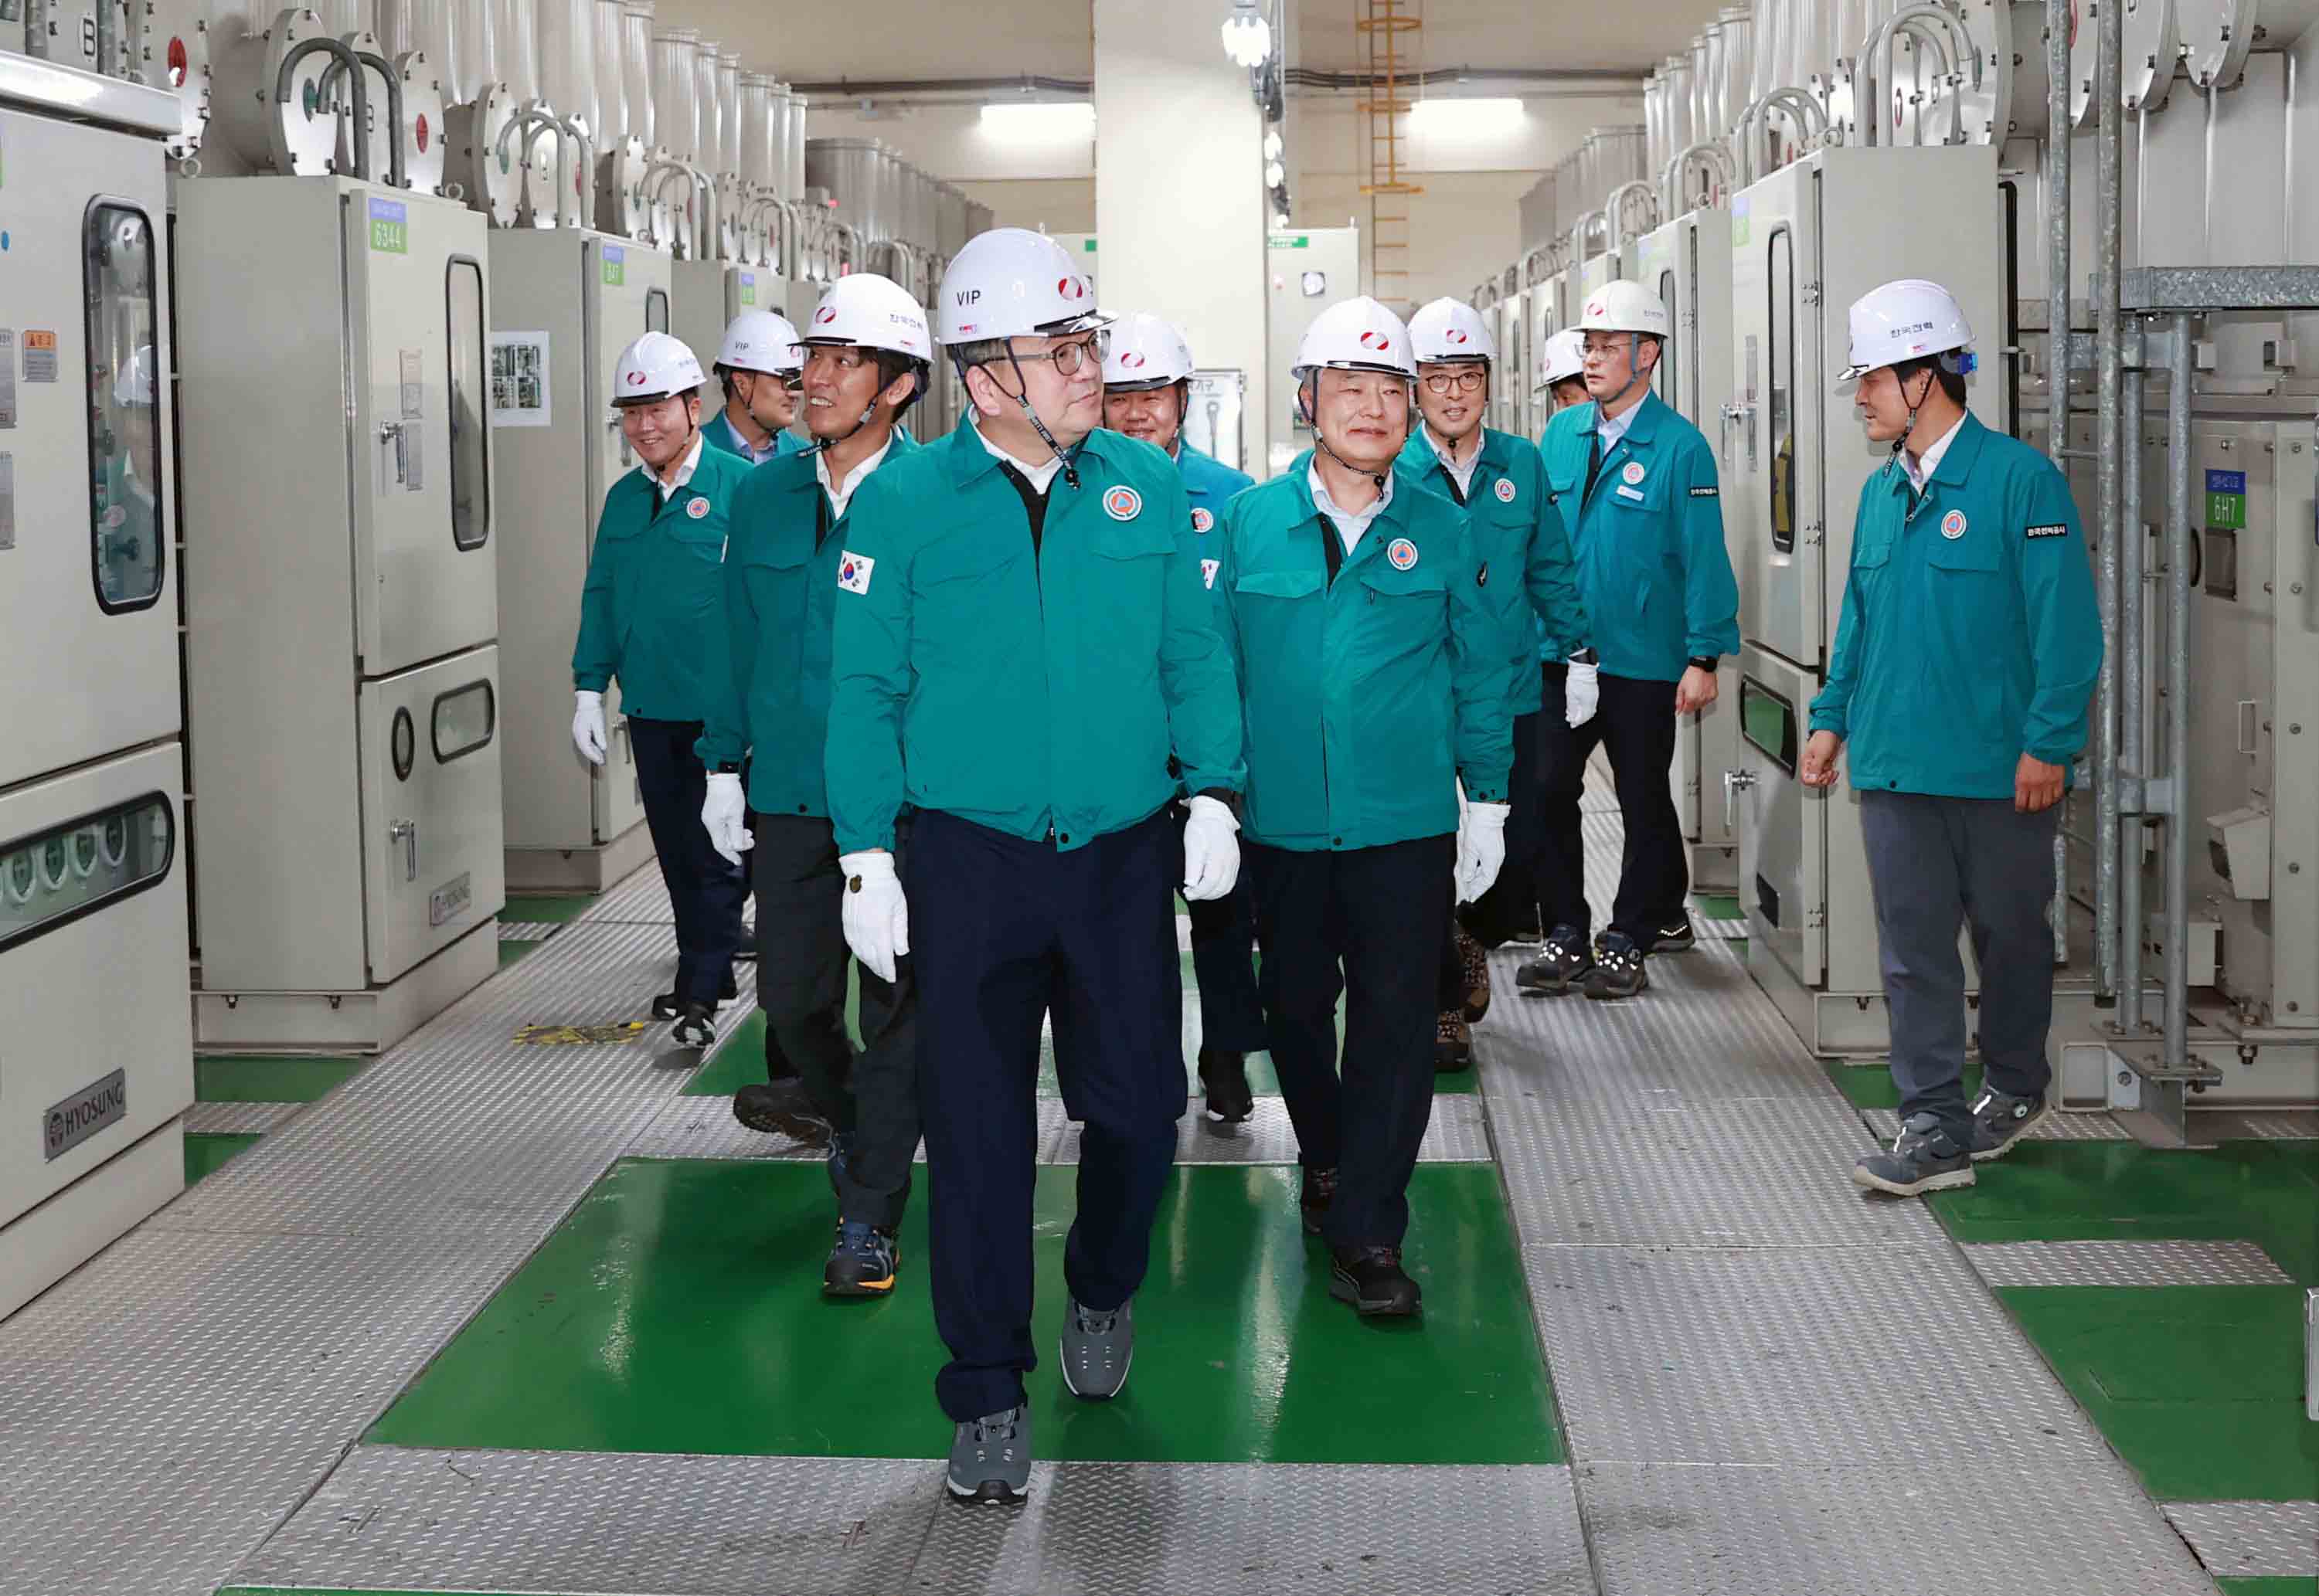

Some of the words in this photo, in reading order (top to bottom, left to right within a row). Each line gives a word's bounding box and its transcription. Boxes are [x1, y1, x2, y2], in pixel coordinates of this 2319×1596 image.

[957, 290, 981, 307] VIP
[735, 341, 749, 351] VIP
[65, 1081, 124, 1136] HYOSUNG
